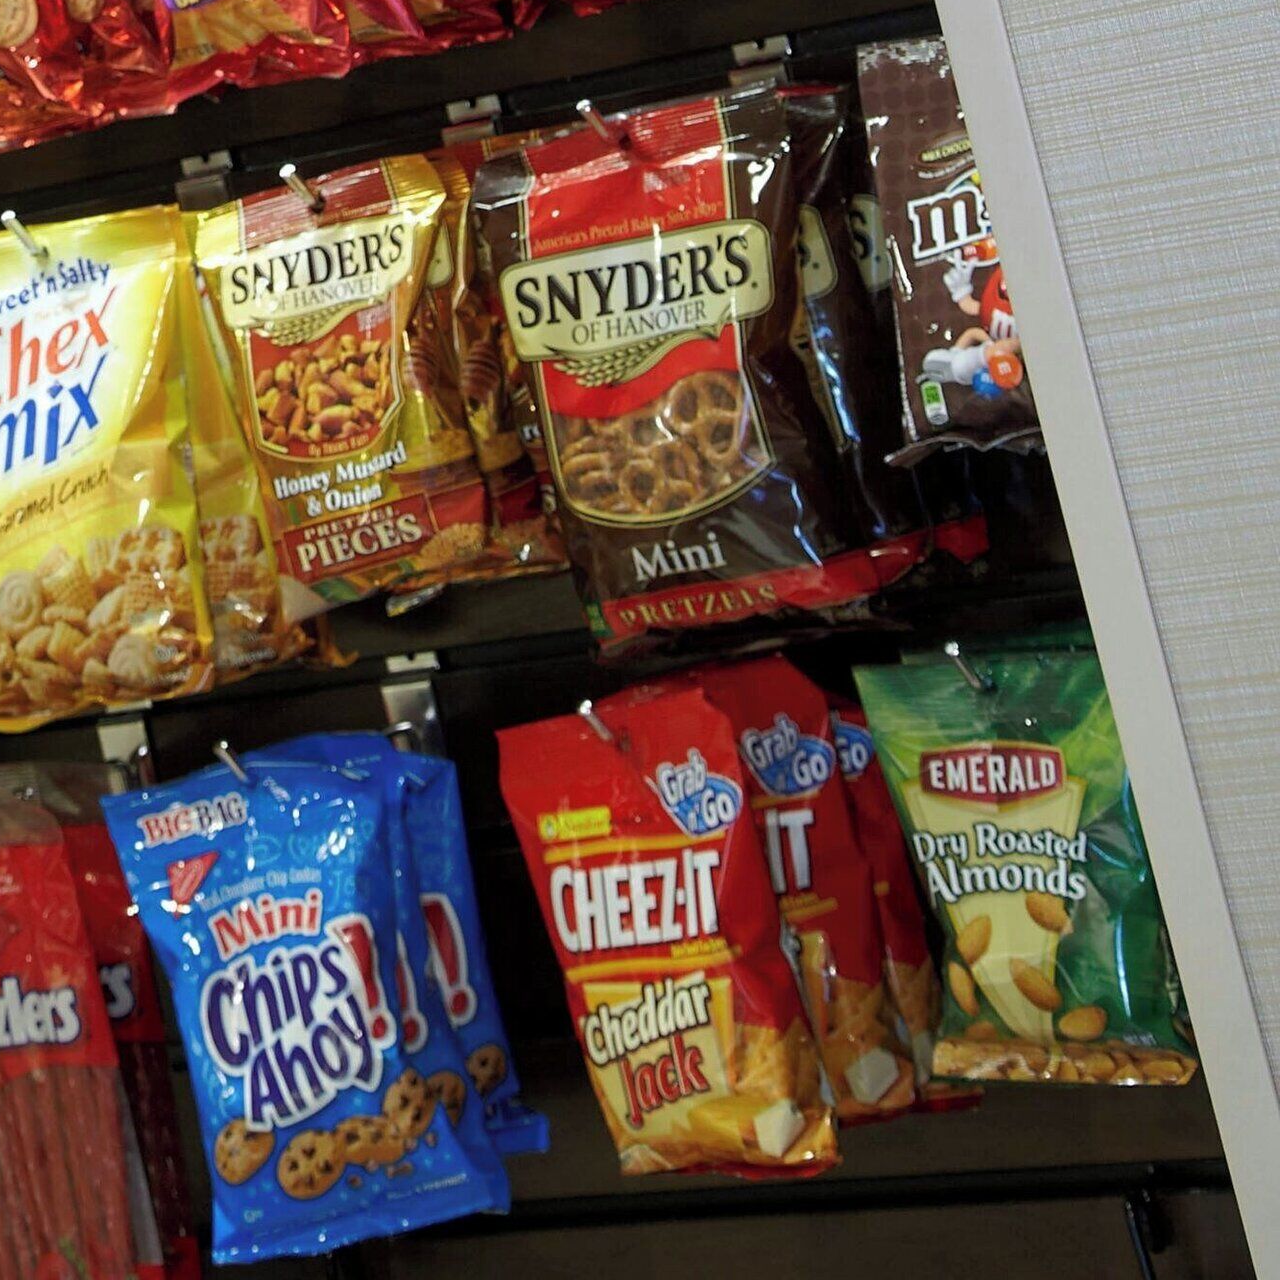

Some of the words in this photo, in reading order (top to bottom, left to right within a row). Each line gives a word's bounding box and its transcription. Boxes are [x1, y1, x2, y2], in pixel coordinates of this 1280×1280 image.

[58, 255, 111, 288] Salty
[231, 223, 406, 306] SNYDER'S
[514, 233, 753, 330] SNYDER'S
[571, 318, 604, 347] OF
[605, 299, 708, 339] HANOVER
[58, 463, 111, 506] Crunch
[273, 468, 332, 500] Honey
[335, 440, 408, 483] Mustard
[303, 504, 400, 541] PRETZEL
[306, 496, 322, 518] &
[324, 481, 383, 513] Onion
[295, 512, 423, 573] PIECES
[630, 531, 727, 582] Mini
[619, 583, 778, 629] PRETZELS
[745, 714, 798, 768] Grab
[657, 748, 707, 806] Grab
[792, 752, 830, 786] Go
[928, 753, 1058, 795] EMERALD
[141, 807, 193, 846] BIG
[701, 790, 736, 829] Go
[912, 831, 969, 864] Dry
[974, 822, 1088, 863] Roasted
[549, 848, 720, 954] CHEEZ-IT
[925, 856, 1088, 910] Almonds
[211, 890, 322, 957] Mini
[206, 943, 350, 1067] Chips
[619, 1031, 711, 1129] Jack
